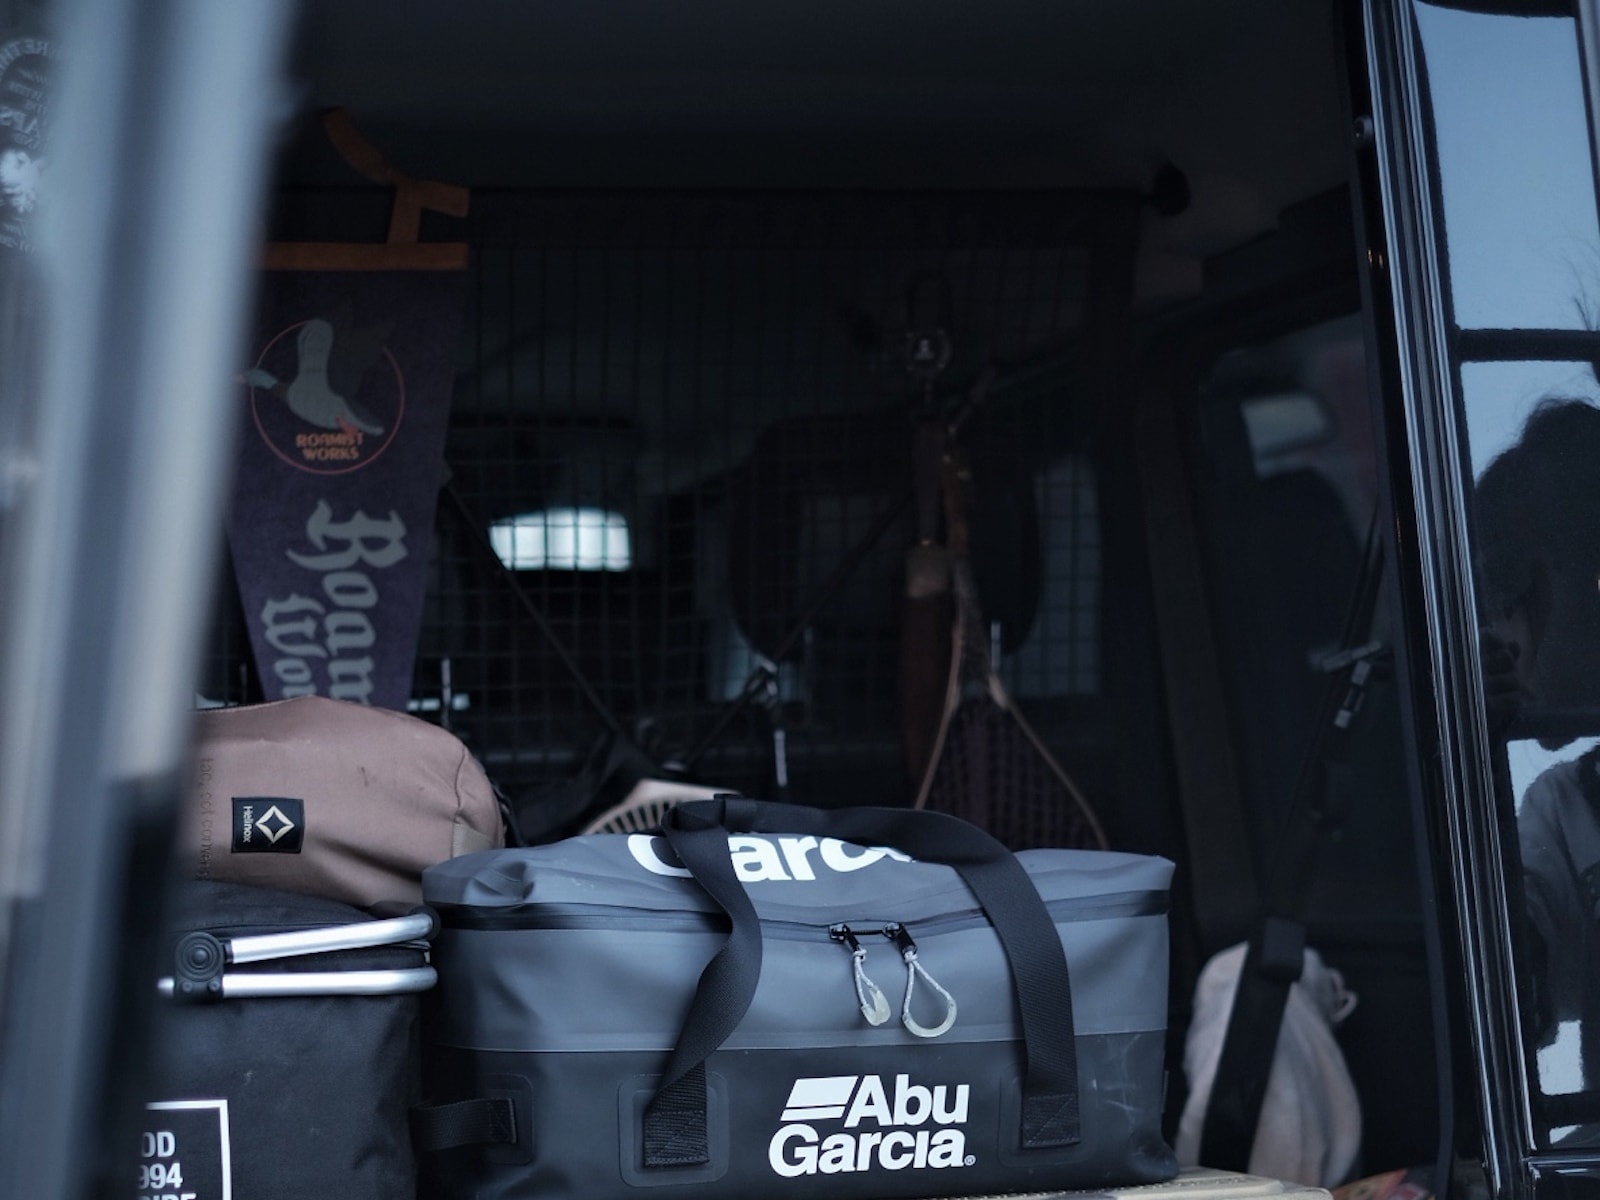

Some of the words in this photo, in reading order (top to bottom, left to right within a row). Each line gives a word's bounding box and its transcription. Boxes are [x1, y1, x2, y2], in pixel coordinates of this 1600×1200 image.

[302, 446, 360, 461] WORKS
[243, 805, 254, 843] Helinox
[843, 1074, 970, 1128] Abu
